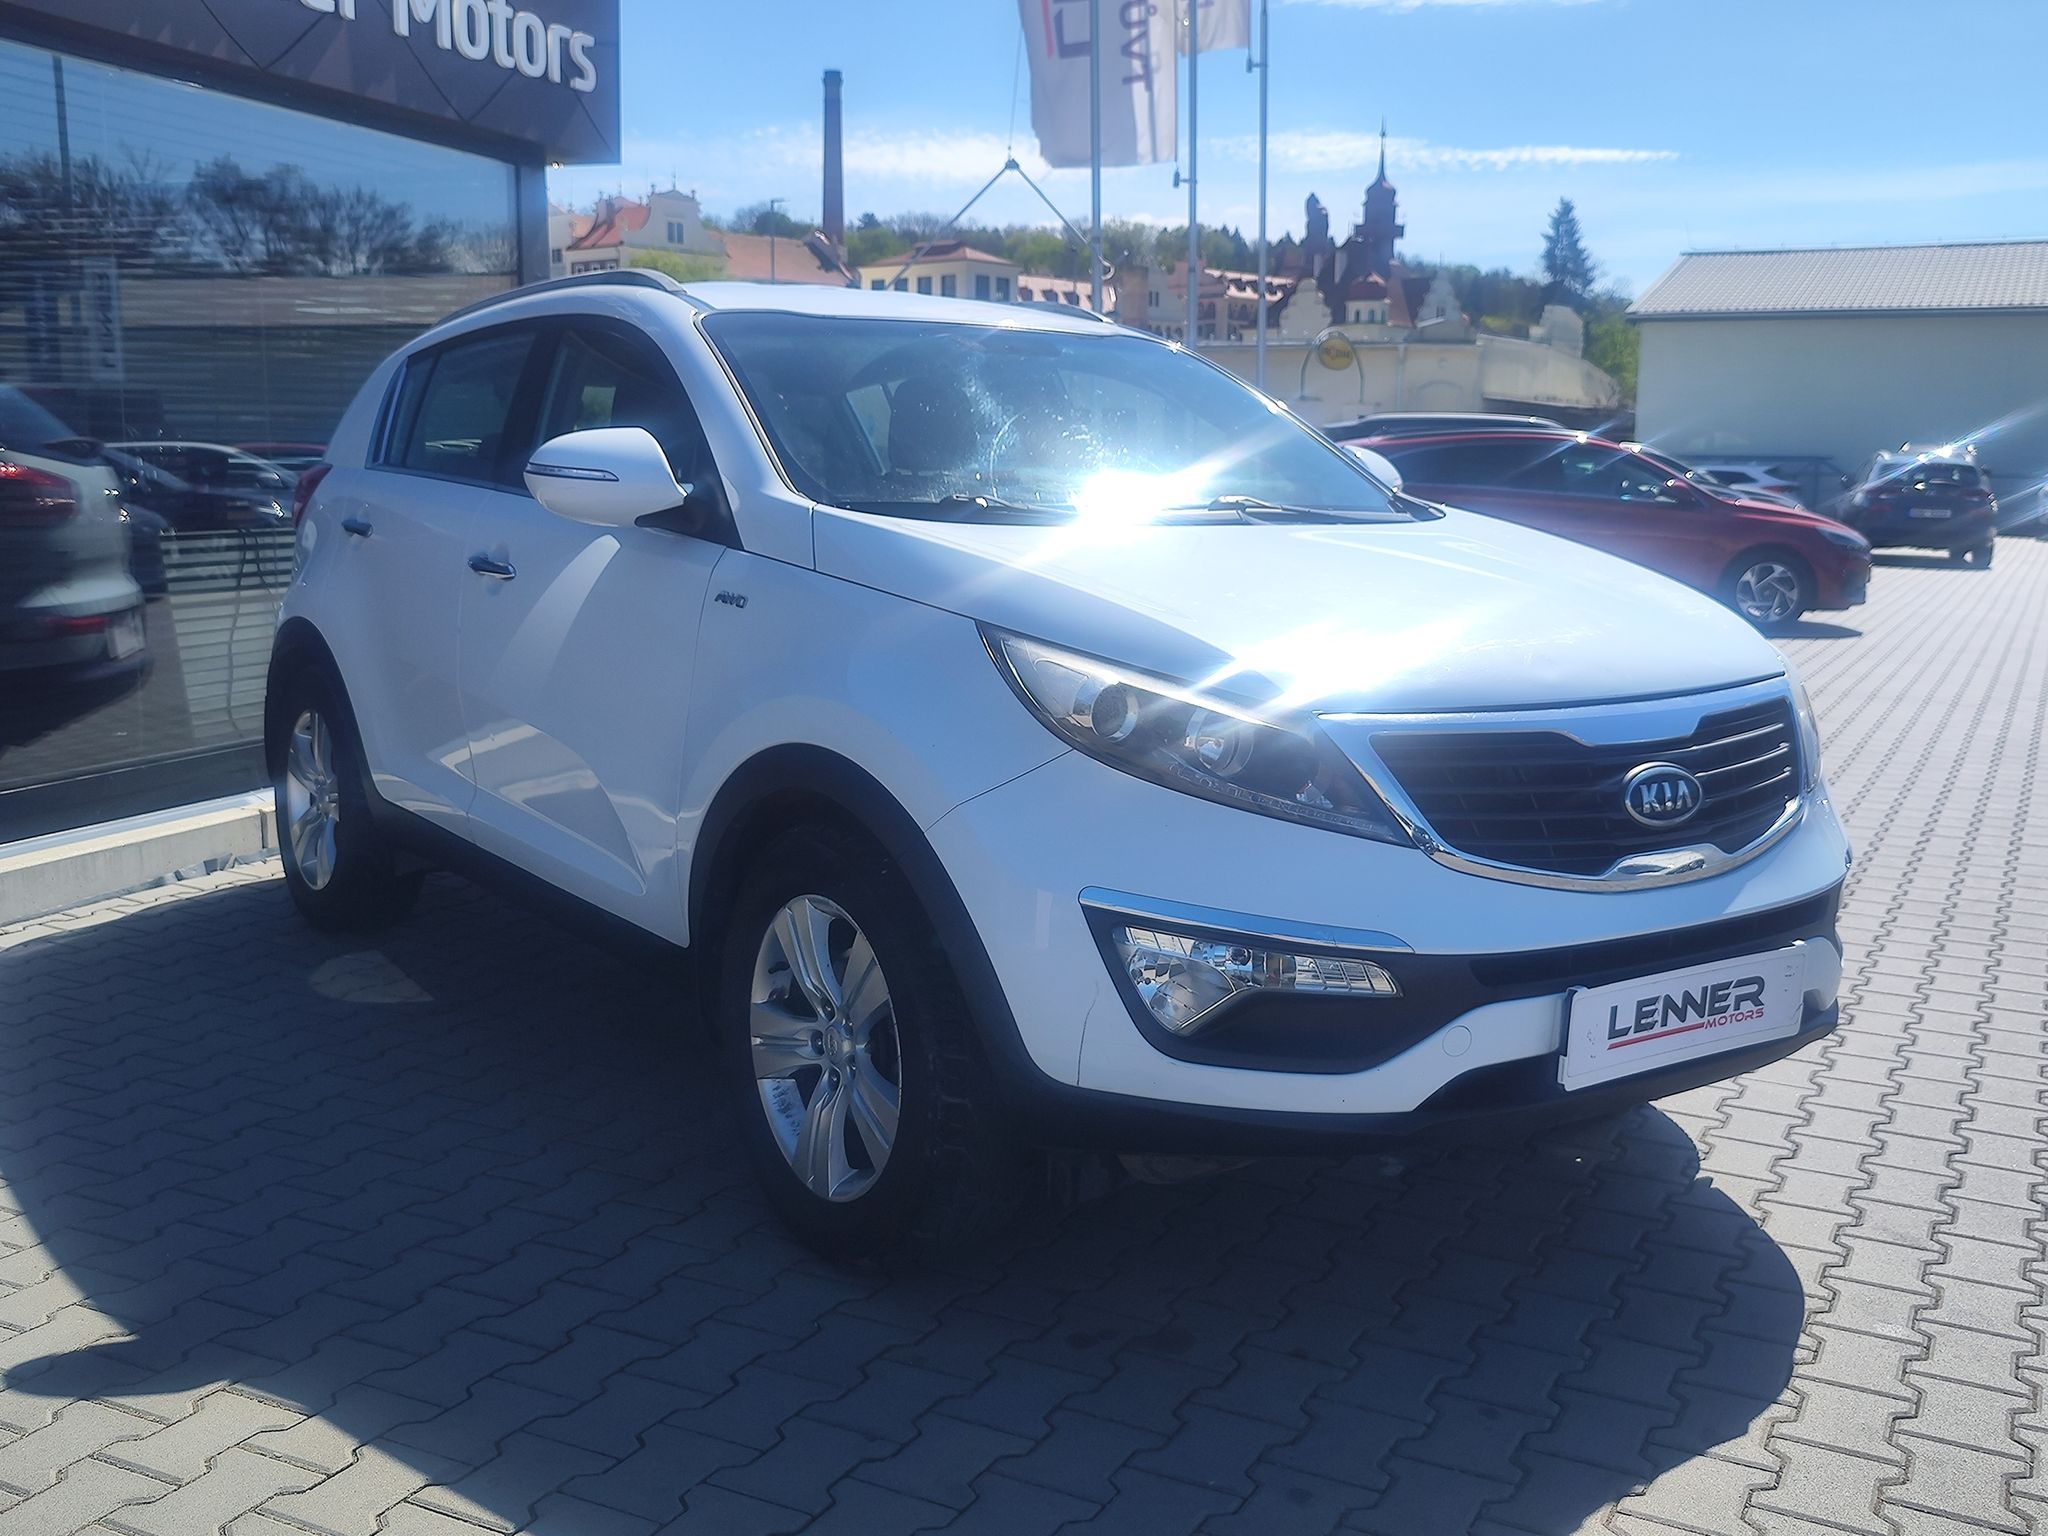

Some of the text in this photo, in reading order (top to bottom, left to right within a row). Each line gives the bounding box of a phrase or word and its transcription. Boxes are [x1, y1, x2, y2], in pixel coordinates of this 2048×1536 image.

[393, 0, 598, 93] Motors
[1639, 780, 1692, 813] KIA
[1607, 975, 1766, 1040] LENNER
[1704, 1007, 1766, 1030] MOTORS
